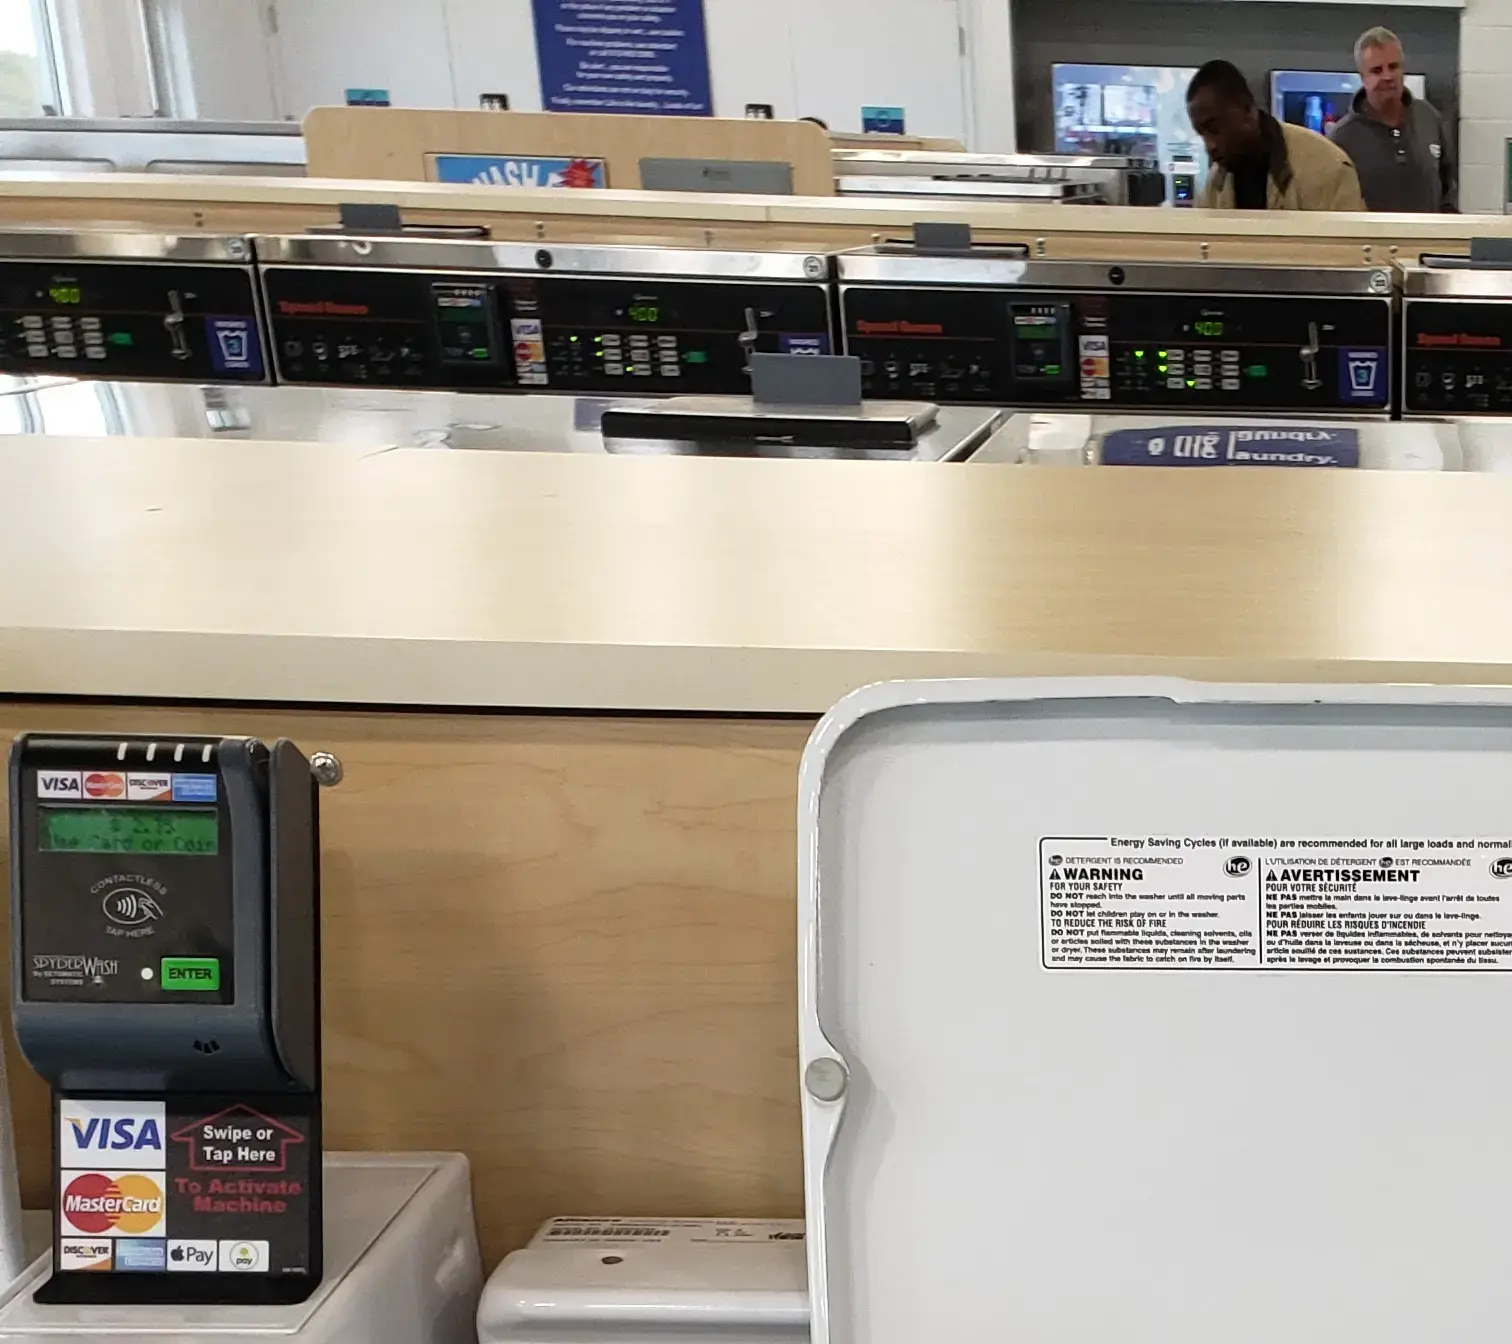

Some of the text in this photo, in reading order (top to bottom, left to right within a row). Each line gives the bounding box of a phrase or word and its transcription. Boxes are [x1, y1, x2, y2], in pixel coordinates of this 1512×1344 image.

[41, 777, 80, 792] VISA
[1111, 837, 1145, 848] Energy
[1148, 837, 1181, 848] Saving
[1184, 838, 1216, 848] Cycles
[1219, 838, 1229, 848] (if
[1231, 838, 1281, 848] available)
[1280, 840, 1295, 848] are
[1298, 839, 1367, 848] recommended
[1370, 839, 1384, 848] for
[1386, 839, 1397, 848] all
[1400, 839, 1425, 850] large
[1427, 839, 1454, 848] loads
[1456, 839, 1475, 848] and
[1063, 868, 1143, 881] WARNING
[1280, 869, 1420, 882] AVERTISSEMENT
[90, 874, 168, 896] CONTACTLESS
[1050, 882, 1123, 891] FOR YOUR SAFETY
[1266, 882, 1357, 892] POUR VOTRE SÉCURITÉ
[1050, 918, 1167, 928] TO REDUCE THE RISK OF FIRE
[1266, 919, 1426, 930] POUR RÉDUIRE LES RISQUES D'INCENDIE
[125, 925, 156, 939] HERE
[168, 967, 212, 981] ENTER
[63, 1117, 162, 1151] VISA
[203, 1124, 274, 1142] Swipe or
[203, 1147, 276, 1164] Tap Here
[175, 1177, 304, 1195] To Activate
[63, 1194, 162, 1214] MasterCard
[193, 1196, 288, 1214] Machine
[186, 1246, 214, 1266] Pay
[235, 1257, 253, 1267] pay
